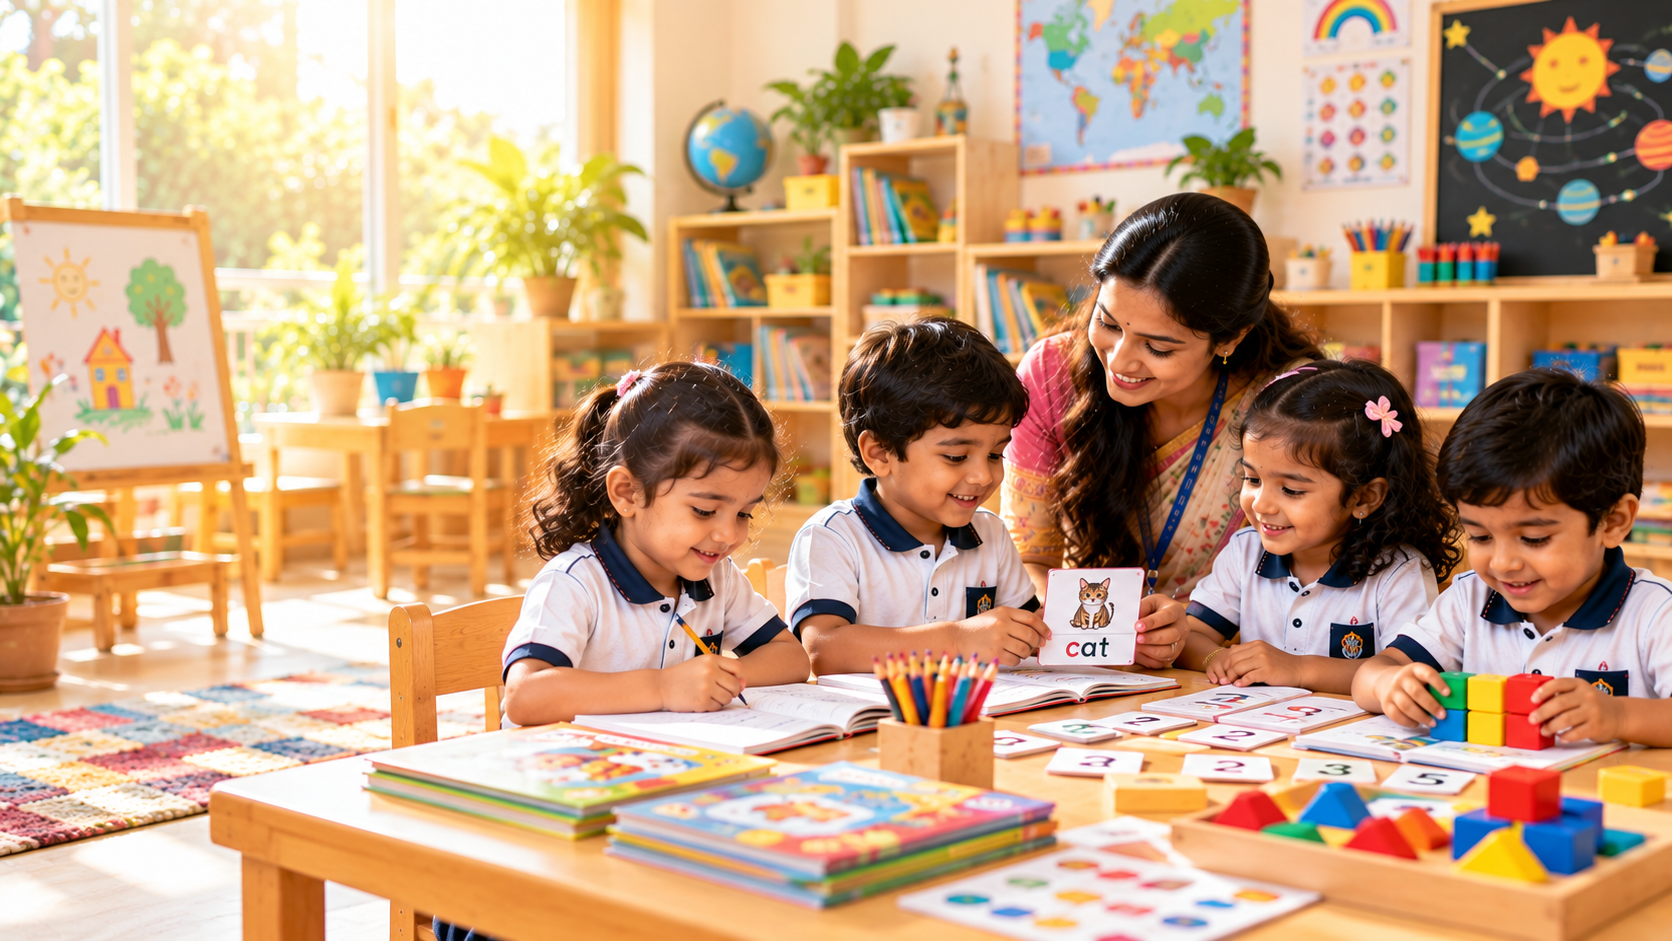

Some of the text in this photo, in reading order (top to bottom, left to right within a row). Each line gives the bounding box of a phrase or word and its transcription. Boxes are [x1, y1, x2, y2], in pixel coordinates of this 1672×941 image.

[1065, 637, 1109, 658] cat
[1123, 716, 1161, 726] 2
[1212, 730, 1256, 742] 2
[1214, 760, 1246, 773] 2
[1318, 763, 1352, 776] 3
[1409, 773, 1449, 785] 5
